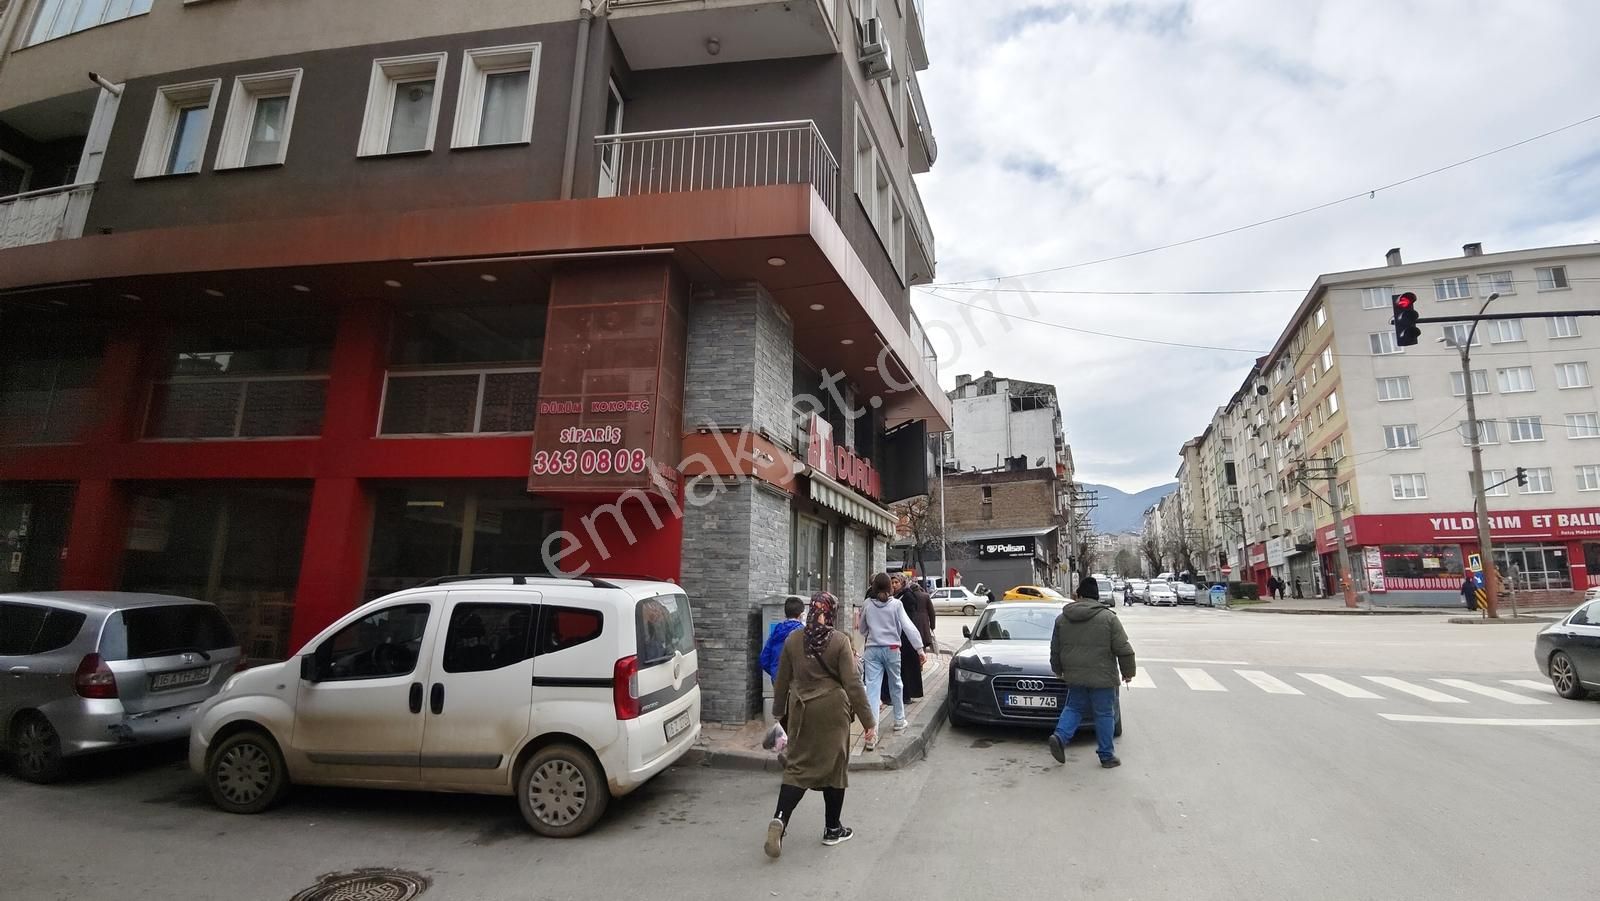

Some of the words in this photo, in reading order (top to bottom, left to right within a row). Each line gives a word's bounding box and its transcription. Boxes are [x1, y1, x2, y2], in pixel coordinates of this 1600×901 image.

[540, 401, 583, 414] DÜRÜM
[591, 400, 650, 413] KOKOREÇ
[560, 425, 621, 444] SİPARİŞ
[533, 449, 577, 475] 363
[1532, 515, 1552, 528] ET
[997, 543, 1026, 553] Polisan
[1009, 695, 1018, 705] 16
[1022, 696, 1034, 706] TT
[1039, 697, 1056, 707] 745
